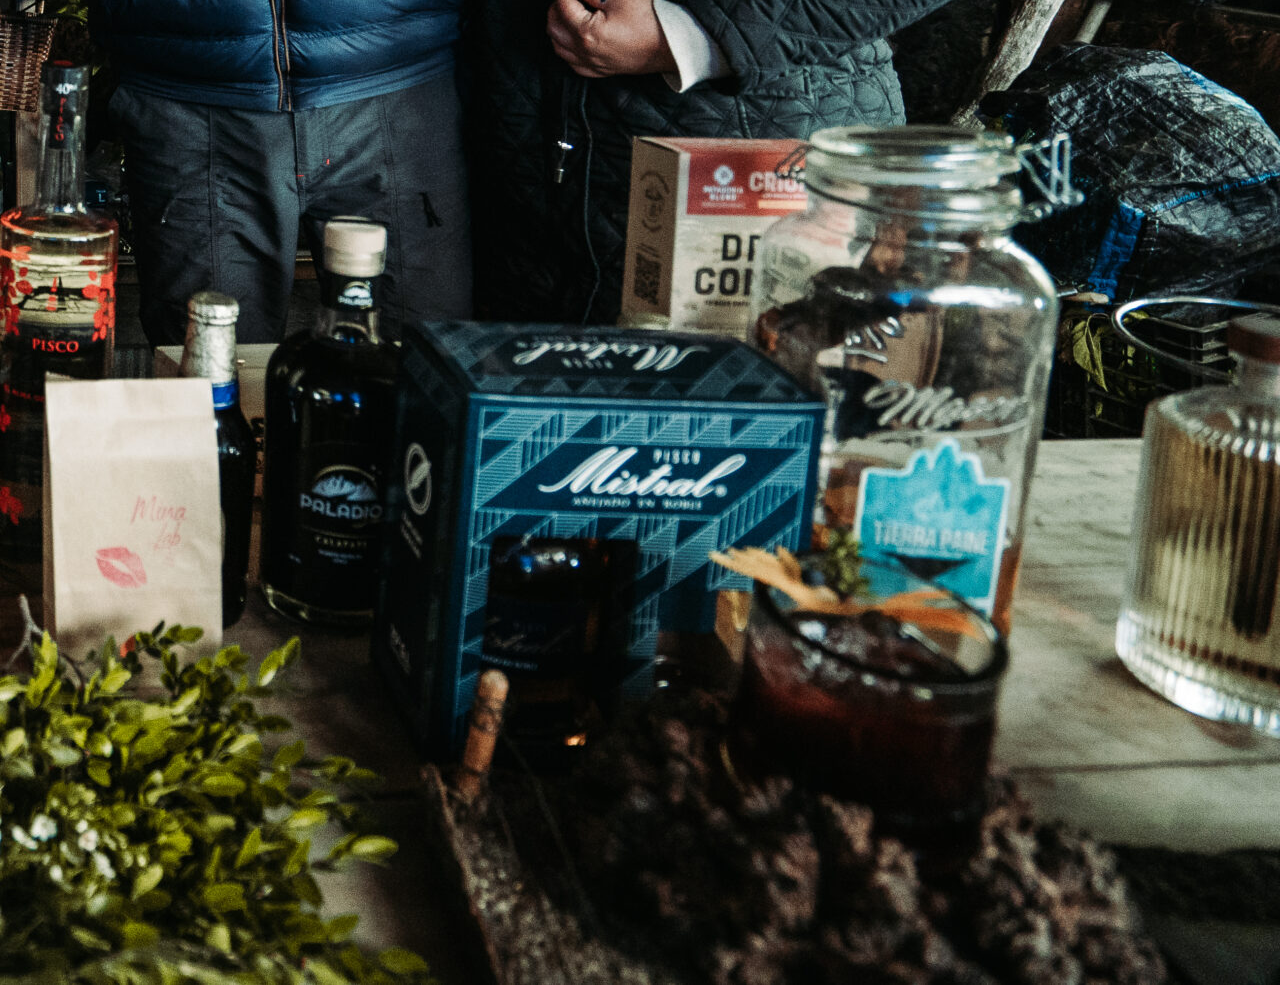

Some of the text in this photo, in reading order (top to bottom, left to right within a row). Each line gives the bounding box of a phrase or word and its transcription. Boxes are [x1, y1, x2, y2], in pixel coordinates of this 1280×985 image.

[55, 96, 67, 141] PISCO
[32, 338, 80, 353] PISCO
[652, 448, 701, 465] PISCO
[537, 446, 748, 498] Mistral
[300, 493, 384, 520] PALADIO
